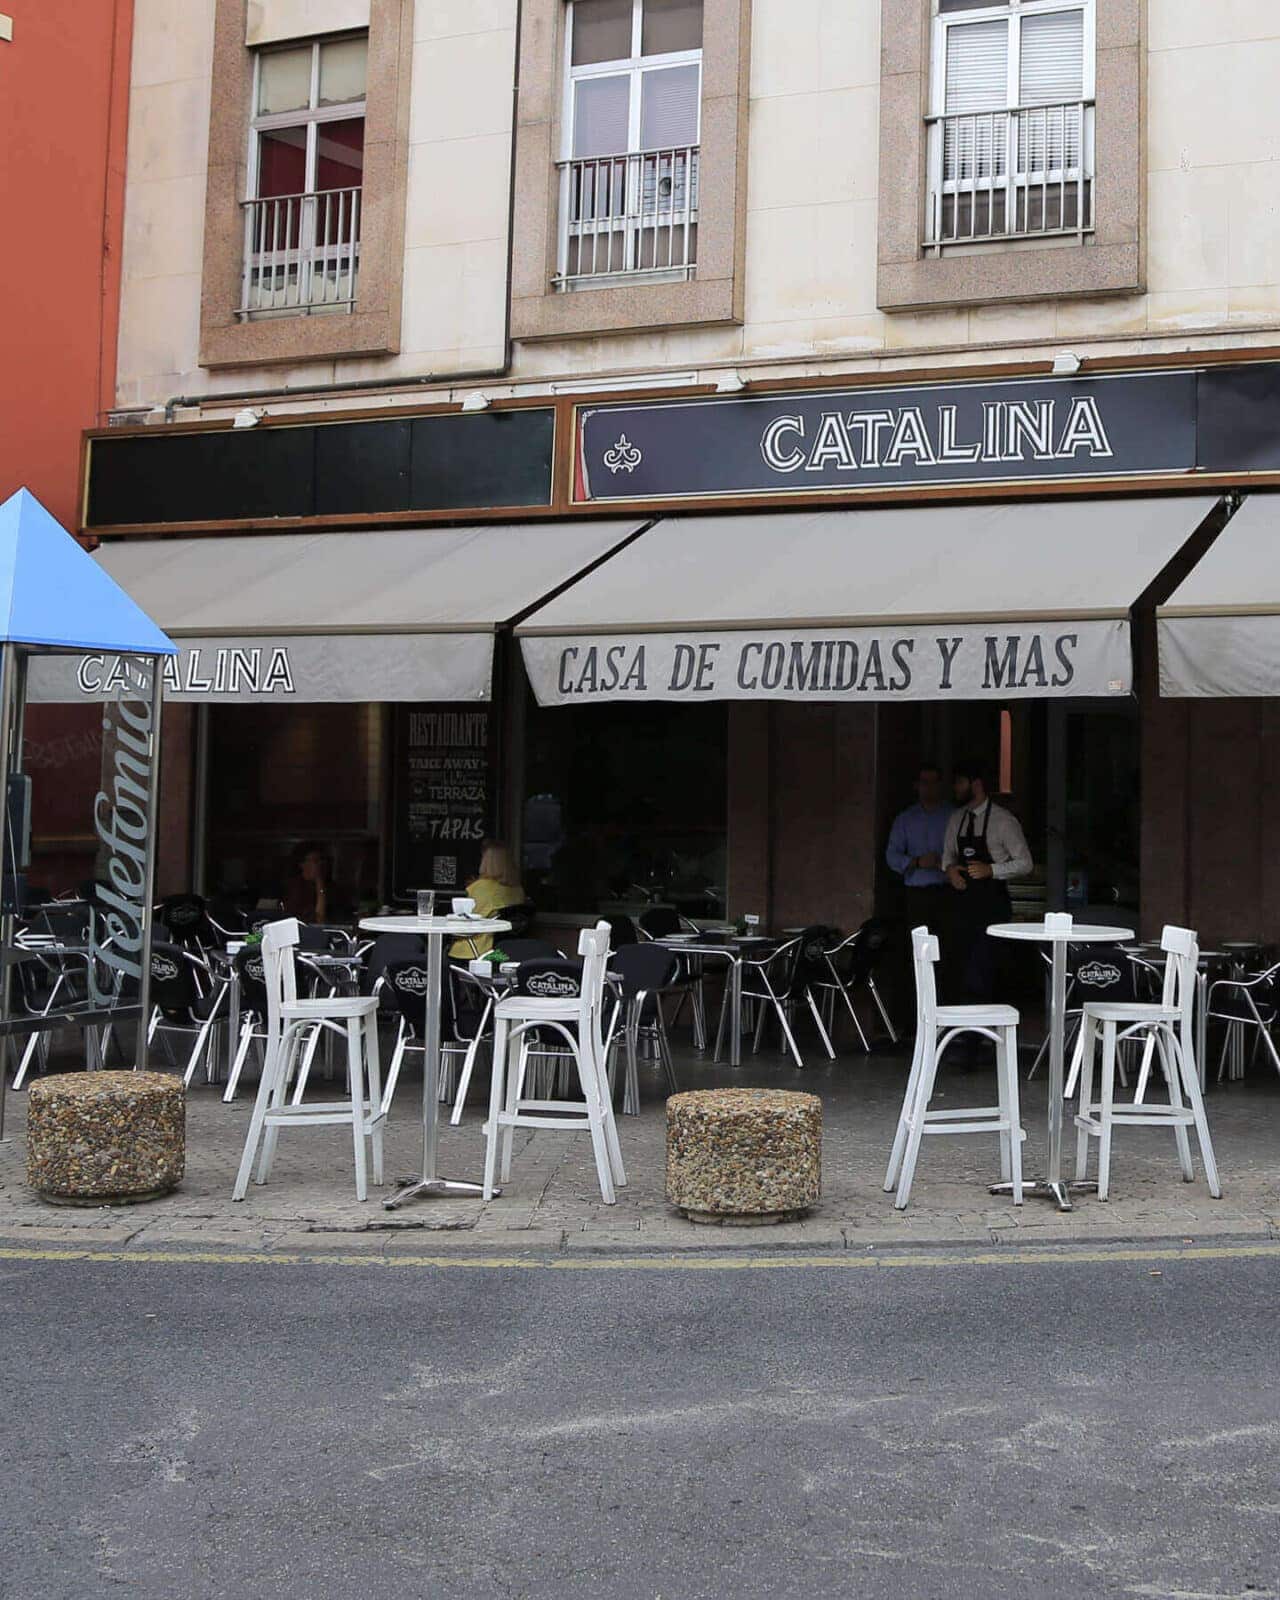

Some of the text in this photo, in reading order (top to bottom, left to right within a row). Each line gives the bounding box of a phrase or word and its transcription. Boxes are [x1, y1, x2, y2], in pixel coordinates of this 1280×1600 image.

[760, 396, 1114, 473] CATALINA
[558, 634, 1079, 695] CASA DE COMIDAS Y MAS
[409, 713, 488, 747] RESTAURANTE
[409, 758, 481, 769] TAKE AWAY
[428, 786, 485, 800] TERRAZA
[430, 818, 485, 840] TAPAS
